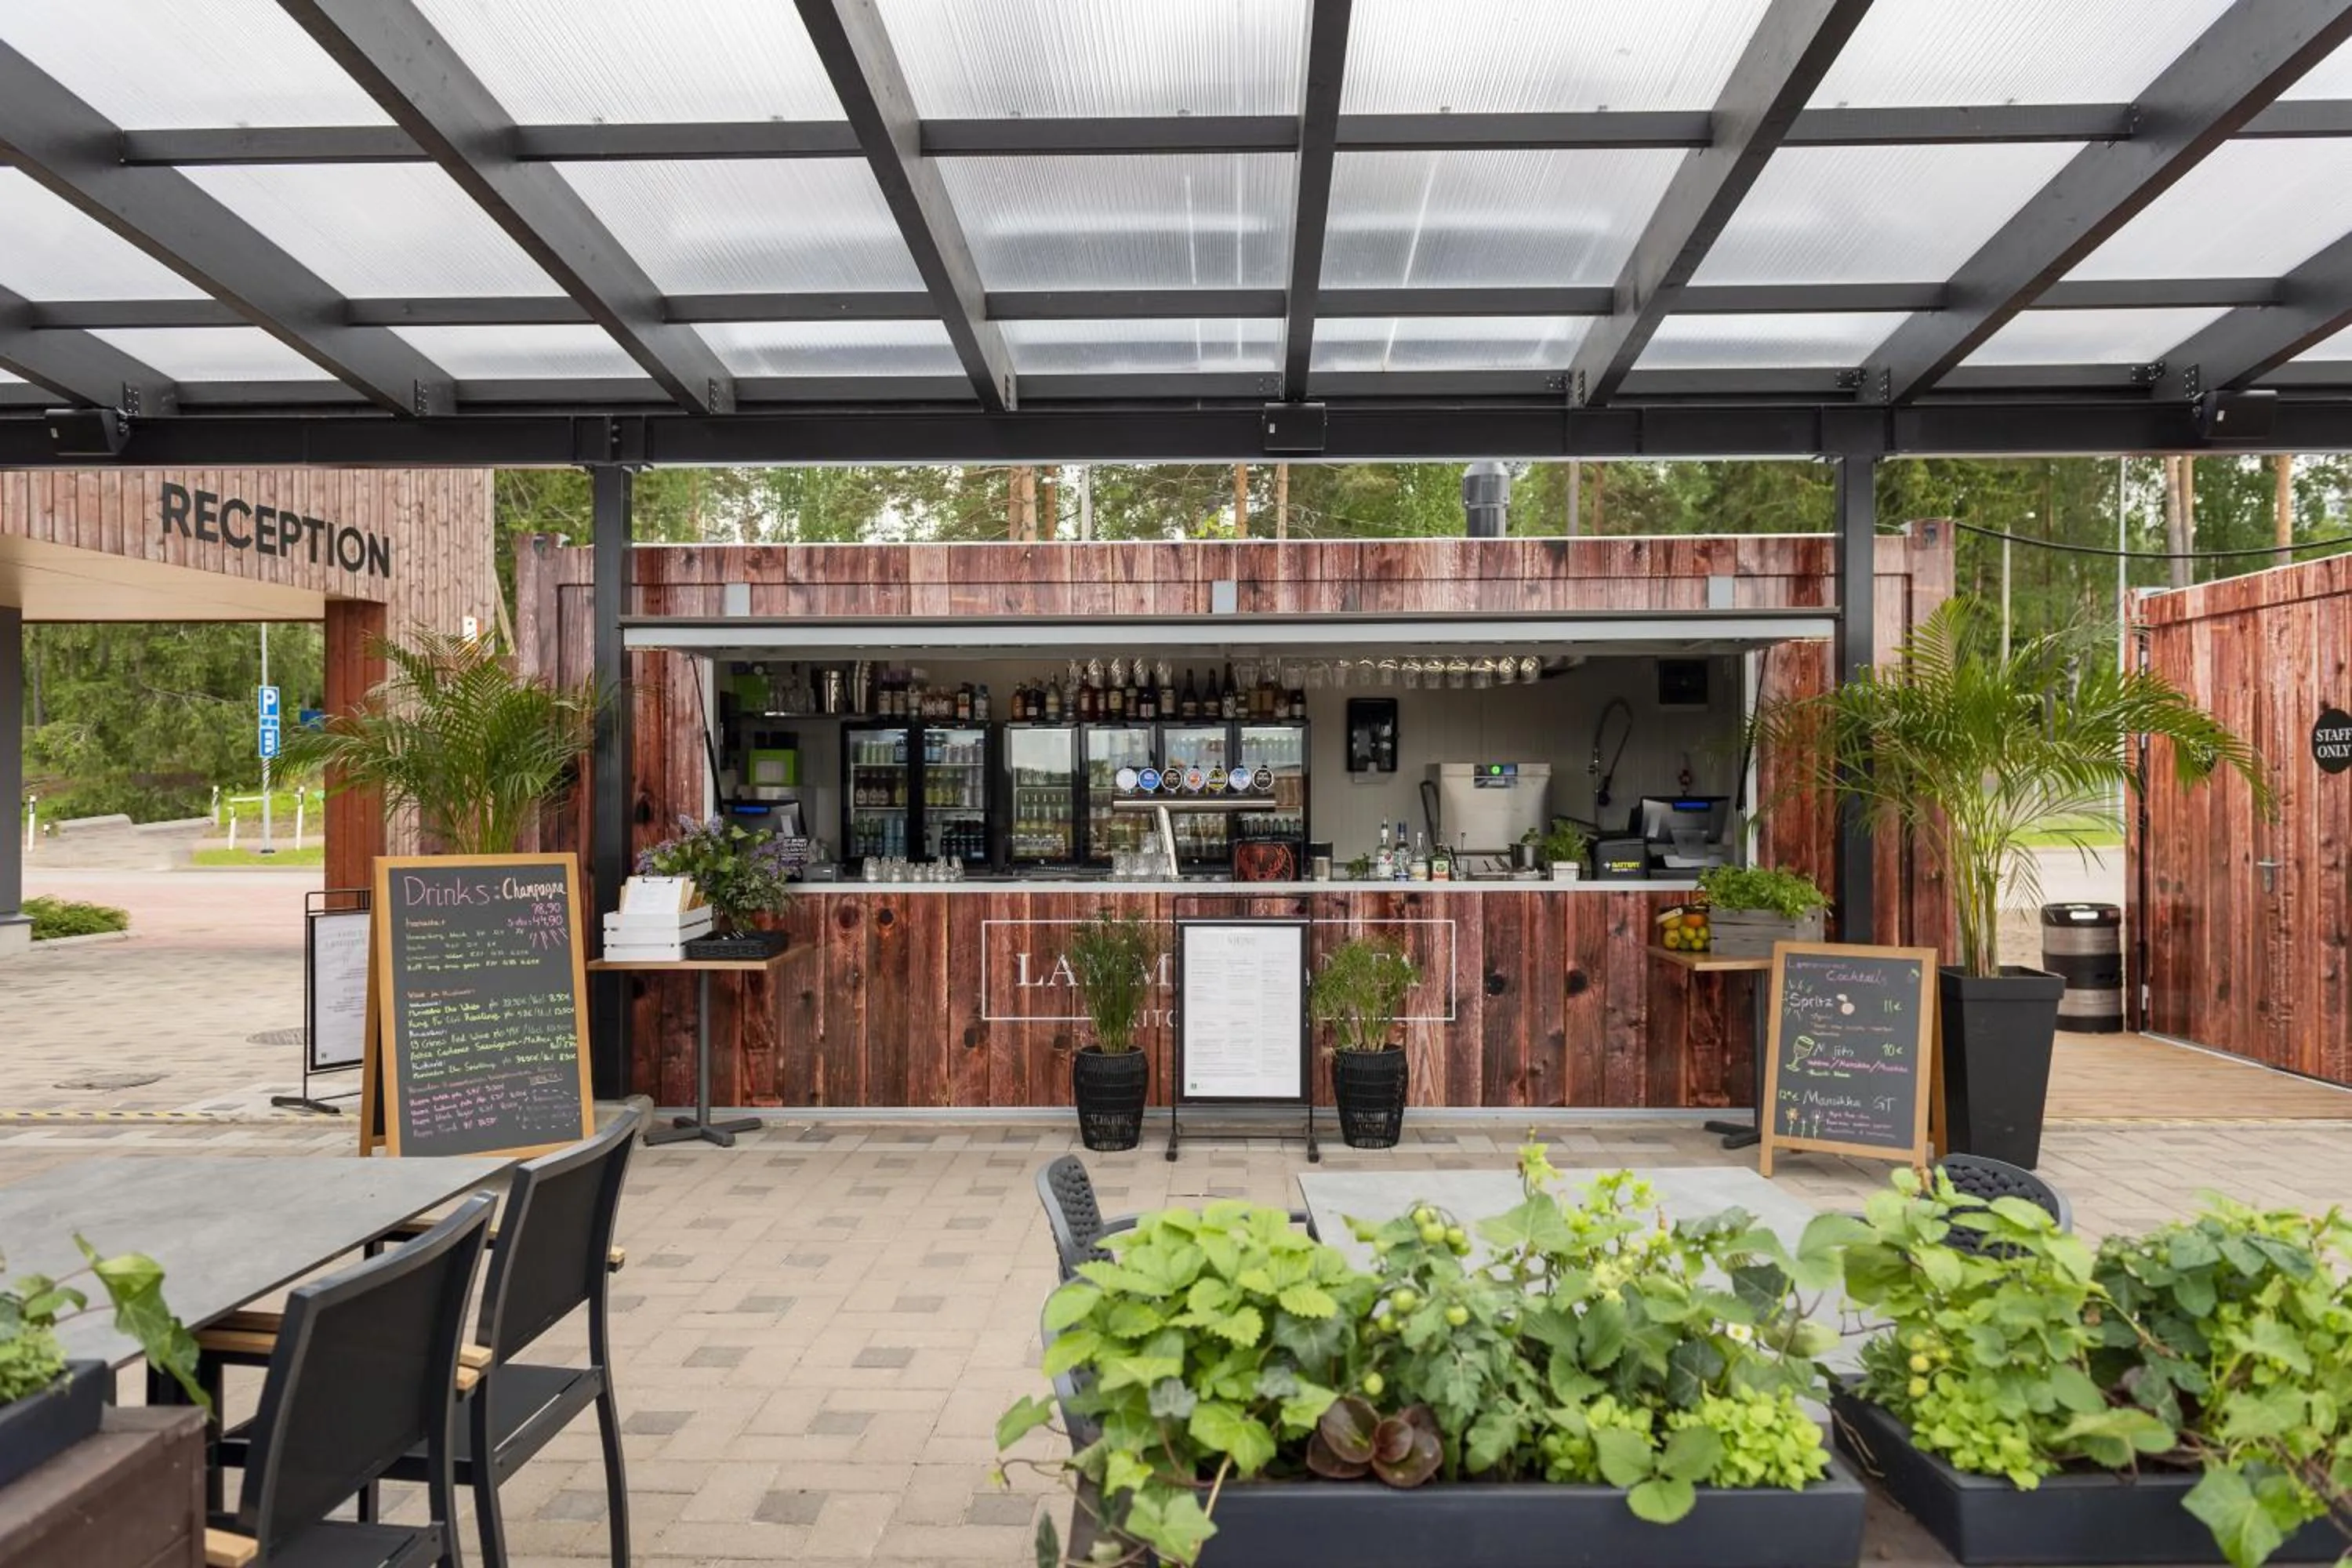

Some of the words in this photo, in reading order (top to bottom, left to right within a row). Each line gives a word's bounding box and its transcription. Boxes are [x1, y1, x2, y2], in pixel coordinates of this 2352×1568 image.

[162, 481, 390, 579] RECEPTION
[263, 689, 276, 714] P
[2316, 728, 2352, 742] STAFF
[2318, 744, 2350, 758] ONLY
[503, 877, 568, 902] Champagne
